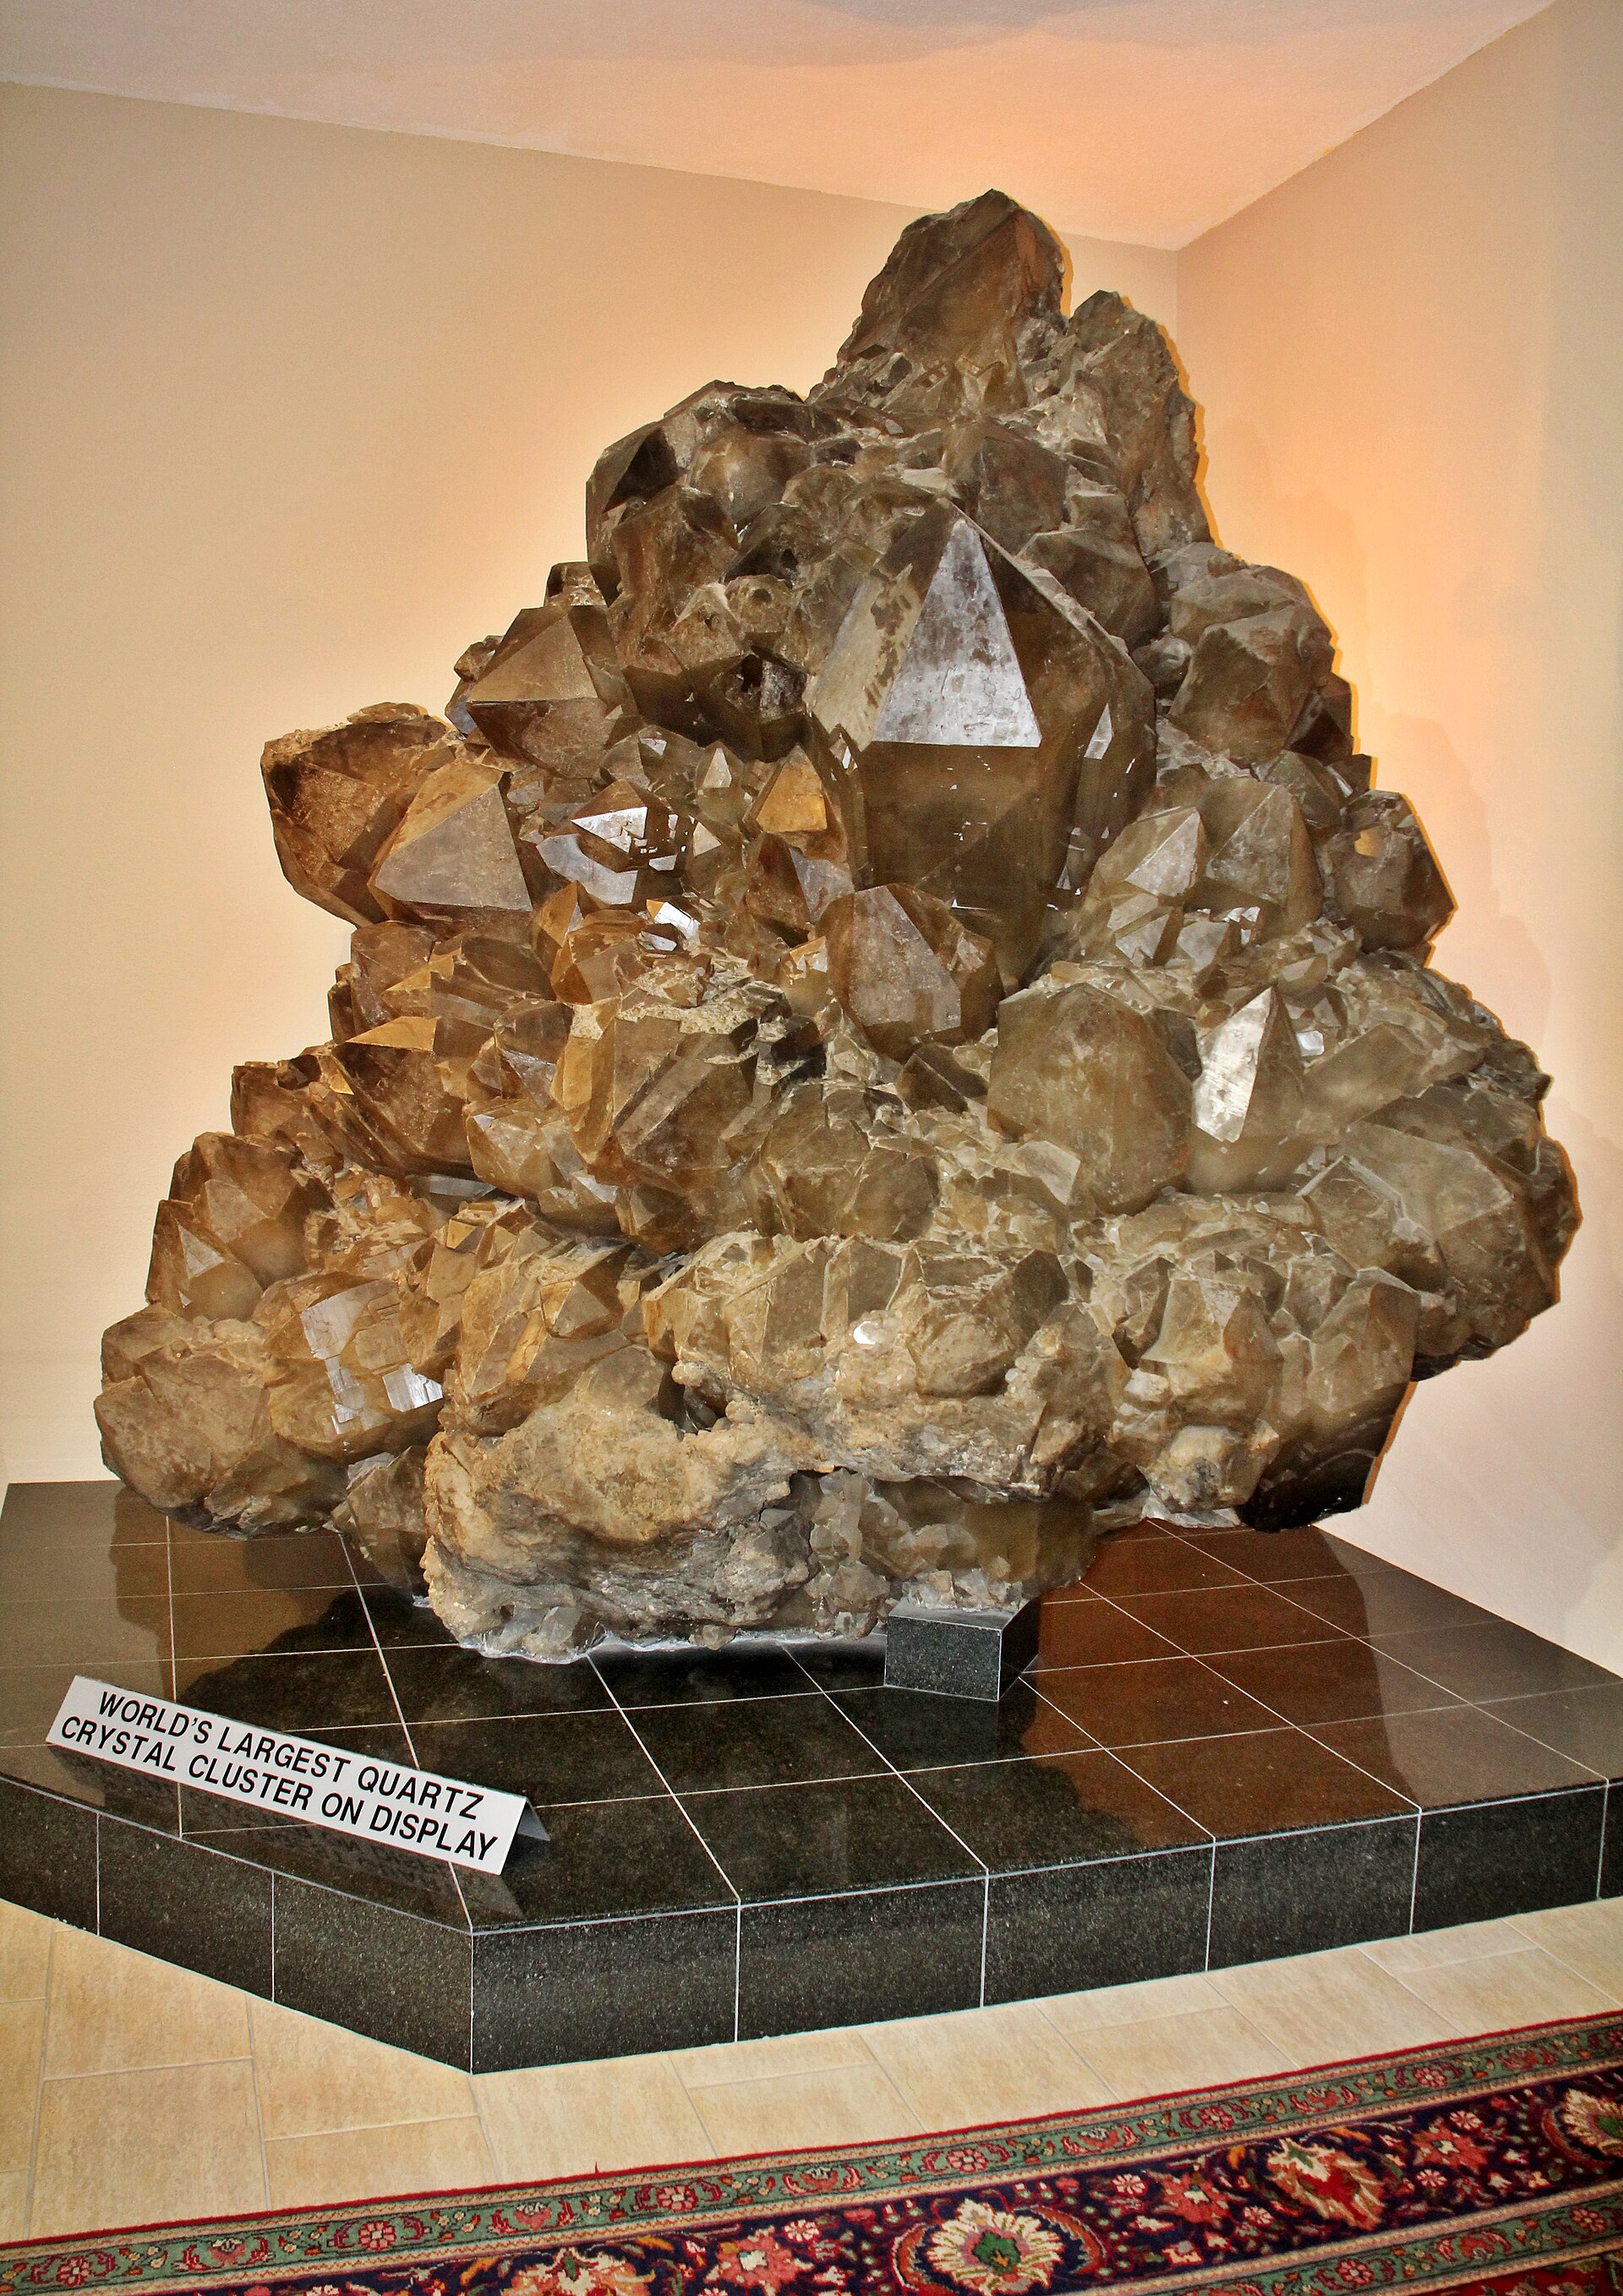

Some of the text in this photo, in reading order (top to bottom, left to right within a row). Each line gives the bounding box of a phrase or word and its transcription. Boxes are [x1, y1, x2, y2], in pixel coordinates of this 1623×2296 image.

[61, 1715, 499, 1861] CRYSTAL CLUSTER ON DISPLAY
[98, 1691, 484, 1821] WORLD'S LARGEST QUARTZ
